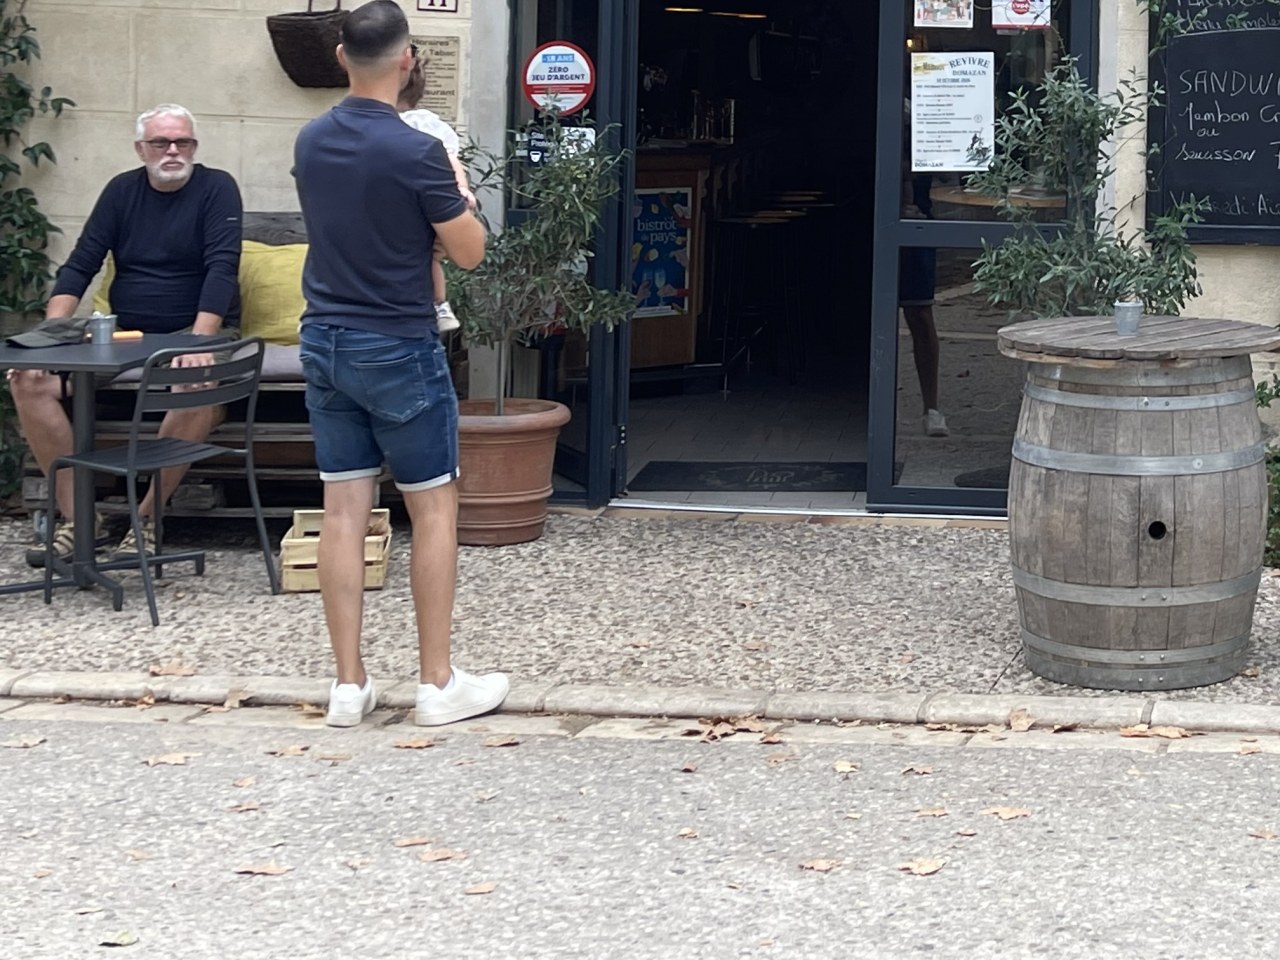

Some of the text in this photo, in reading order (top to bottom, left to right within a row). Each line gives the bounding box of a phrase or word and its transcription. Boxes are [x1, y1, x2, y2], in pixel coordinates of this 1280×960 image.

[429, 48, 456, 57] Tabac
[948, 56, 991, 69] REVIVRE
[532, 73, 585, 81] JEU D'ARGENT
[1178, 100, 1250, 131] Jambon
[1196, 127, 1220, 137] ou
[650, 230, 677, 245] pays
